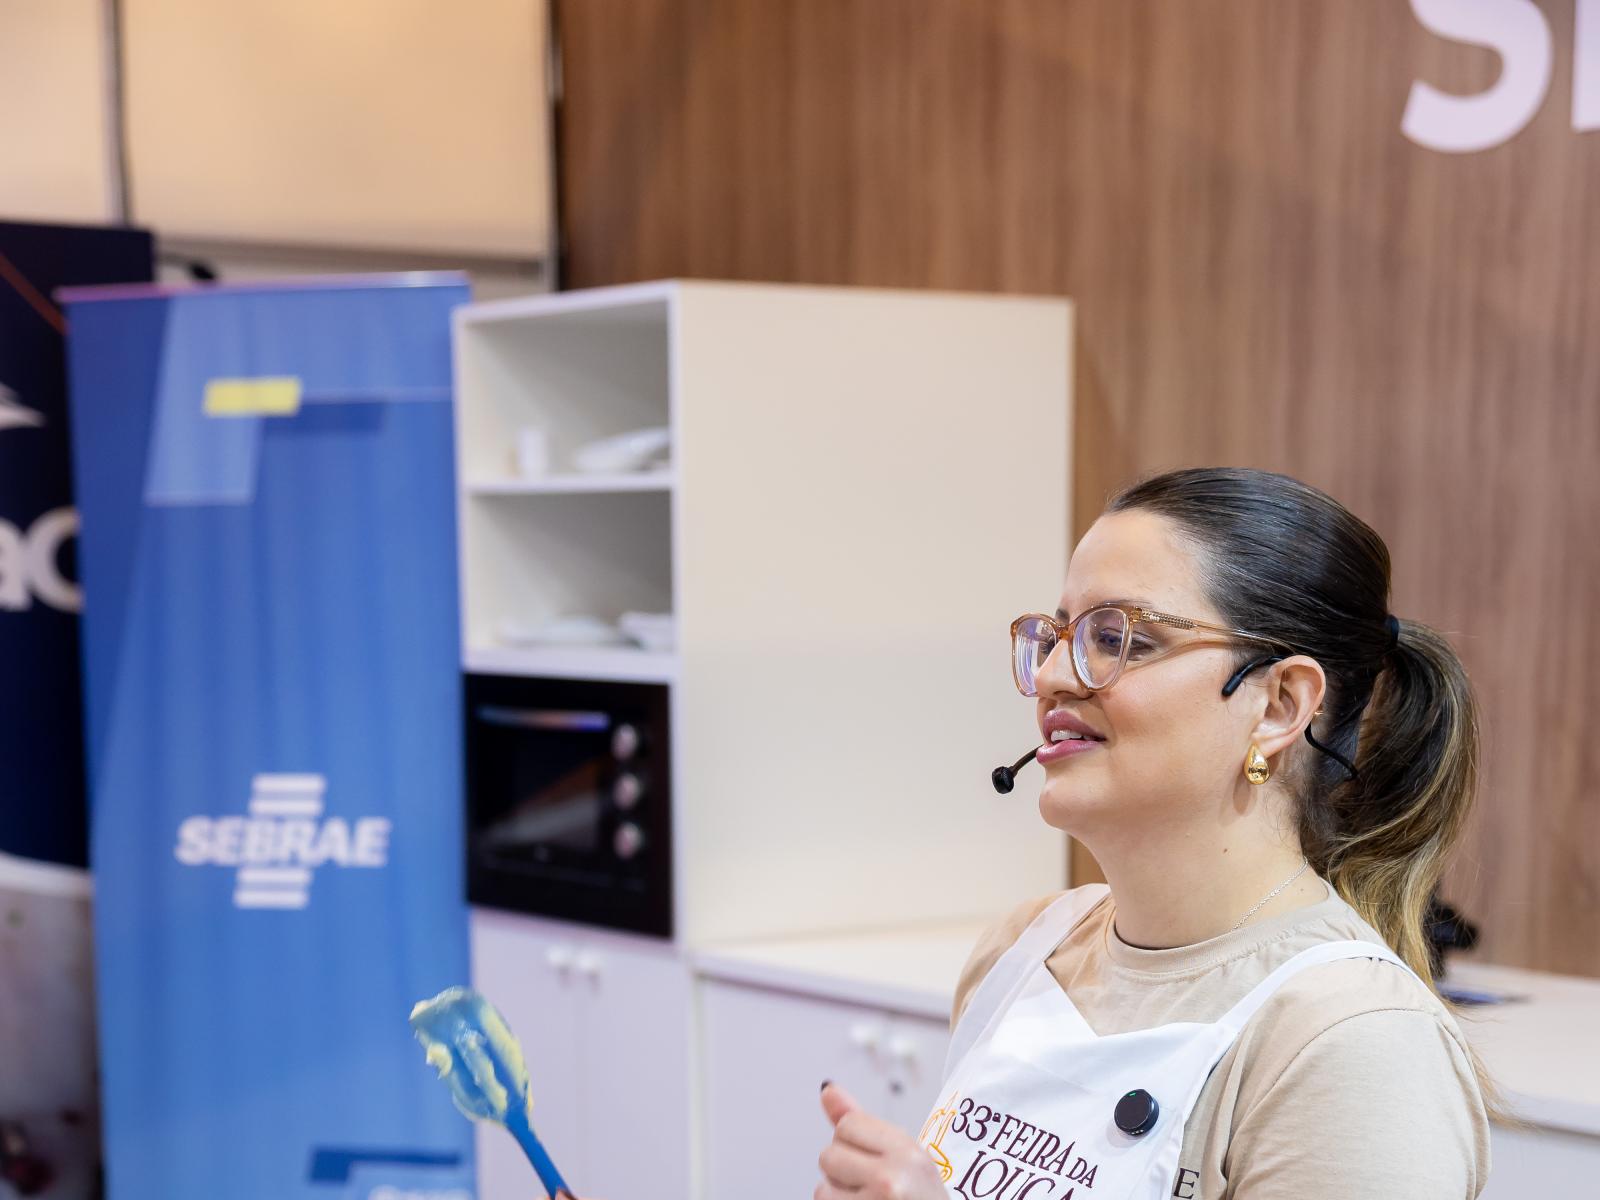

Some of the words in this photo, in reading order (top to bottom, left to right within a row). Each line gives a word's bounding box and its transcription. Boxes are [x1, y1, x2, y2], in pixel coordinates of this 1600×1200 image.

[175, 815, 391, 867] SEBRAE
[987, 1114, 1076, 1176] FEIRA
[1065, 1156, 1098, 1189] DA
